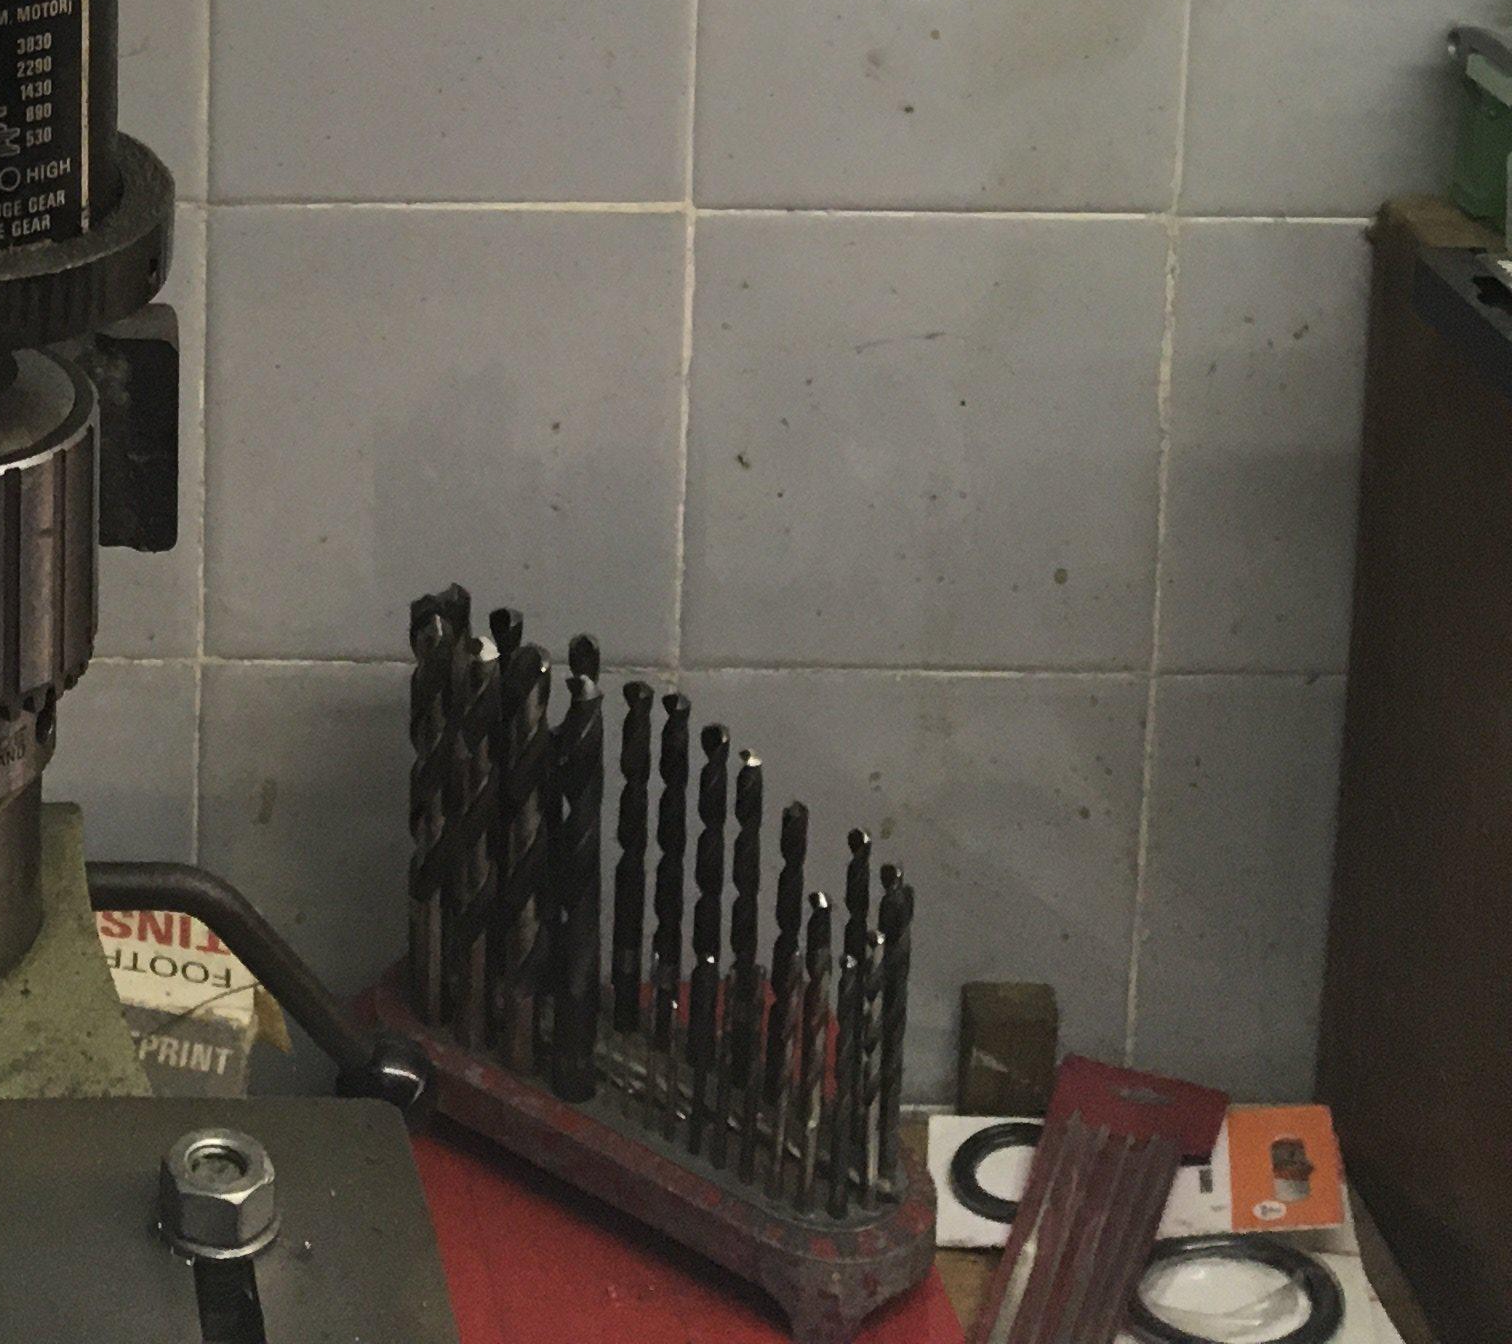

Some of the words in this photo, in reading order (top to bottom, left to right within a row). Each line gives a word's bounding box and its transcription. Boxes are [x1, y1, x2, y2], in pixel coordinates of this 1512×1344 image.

[17, 32, 52, 55] 3830
[17, 56, 52, 78] 2290
[20, 79, 52, 101] 1430
[26, 158, 71, 183] HIGH
[28, 189, 66, 213] GEAR
[11, 214, 51, 238] GEAR
